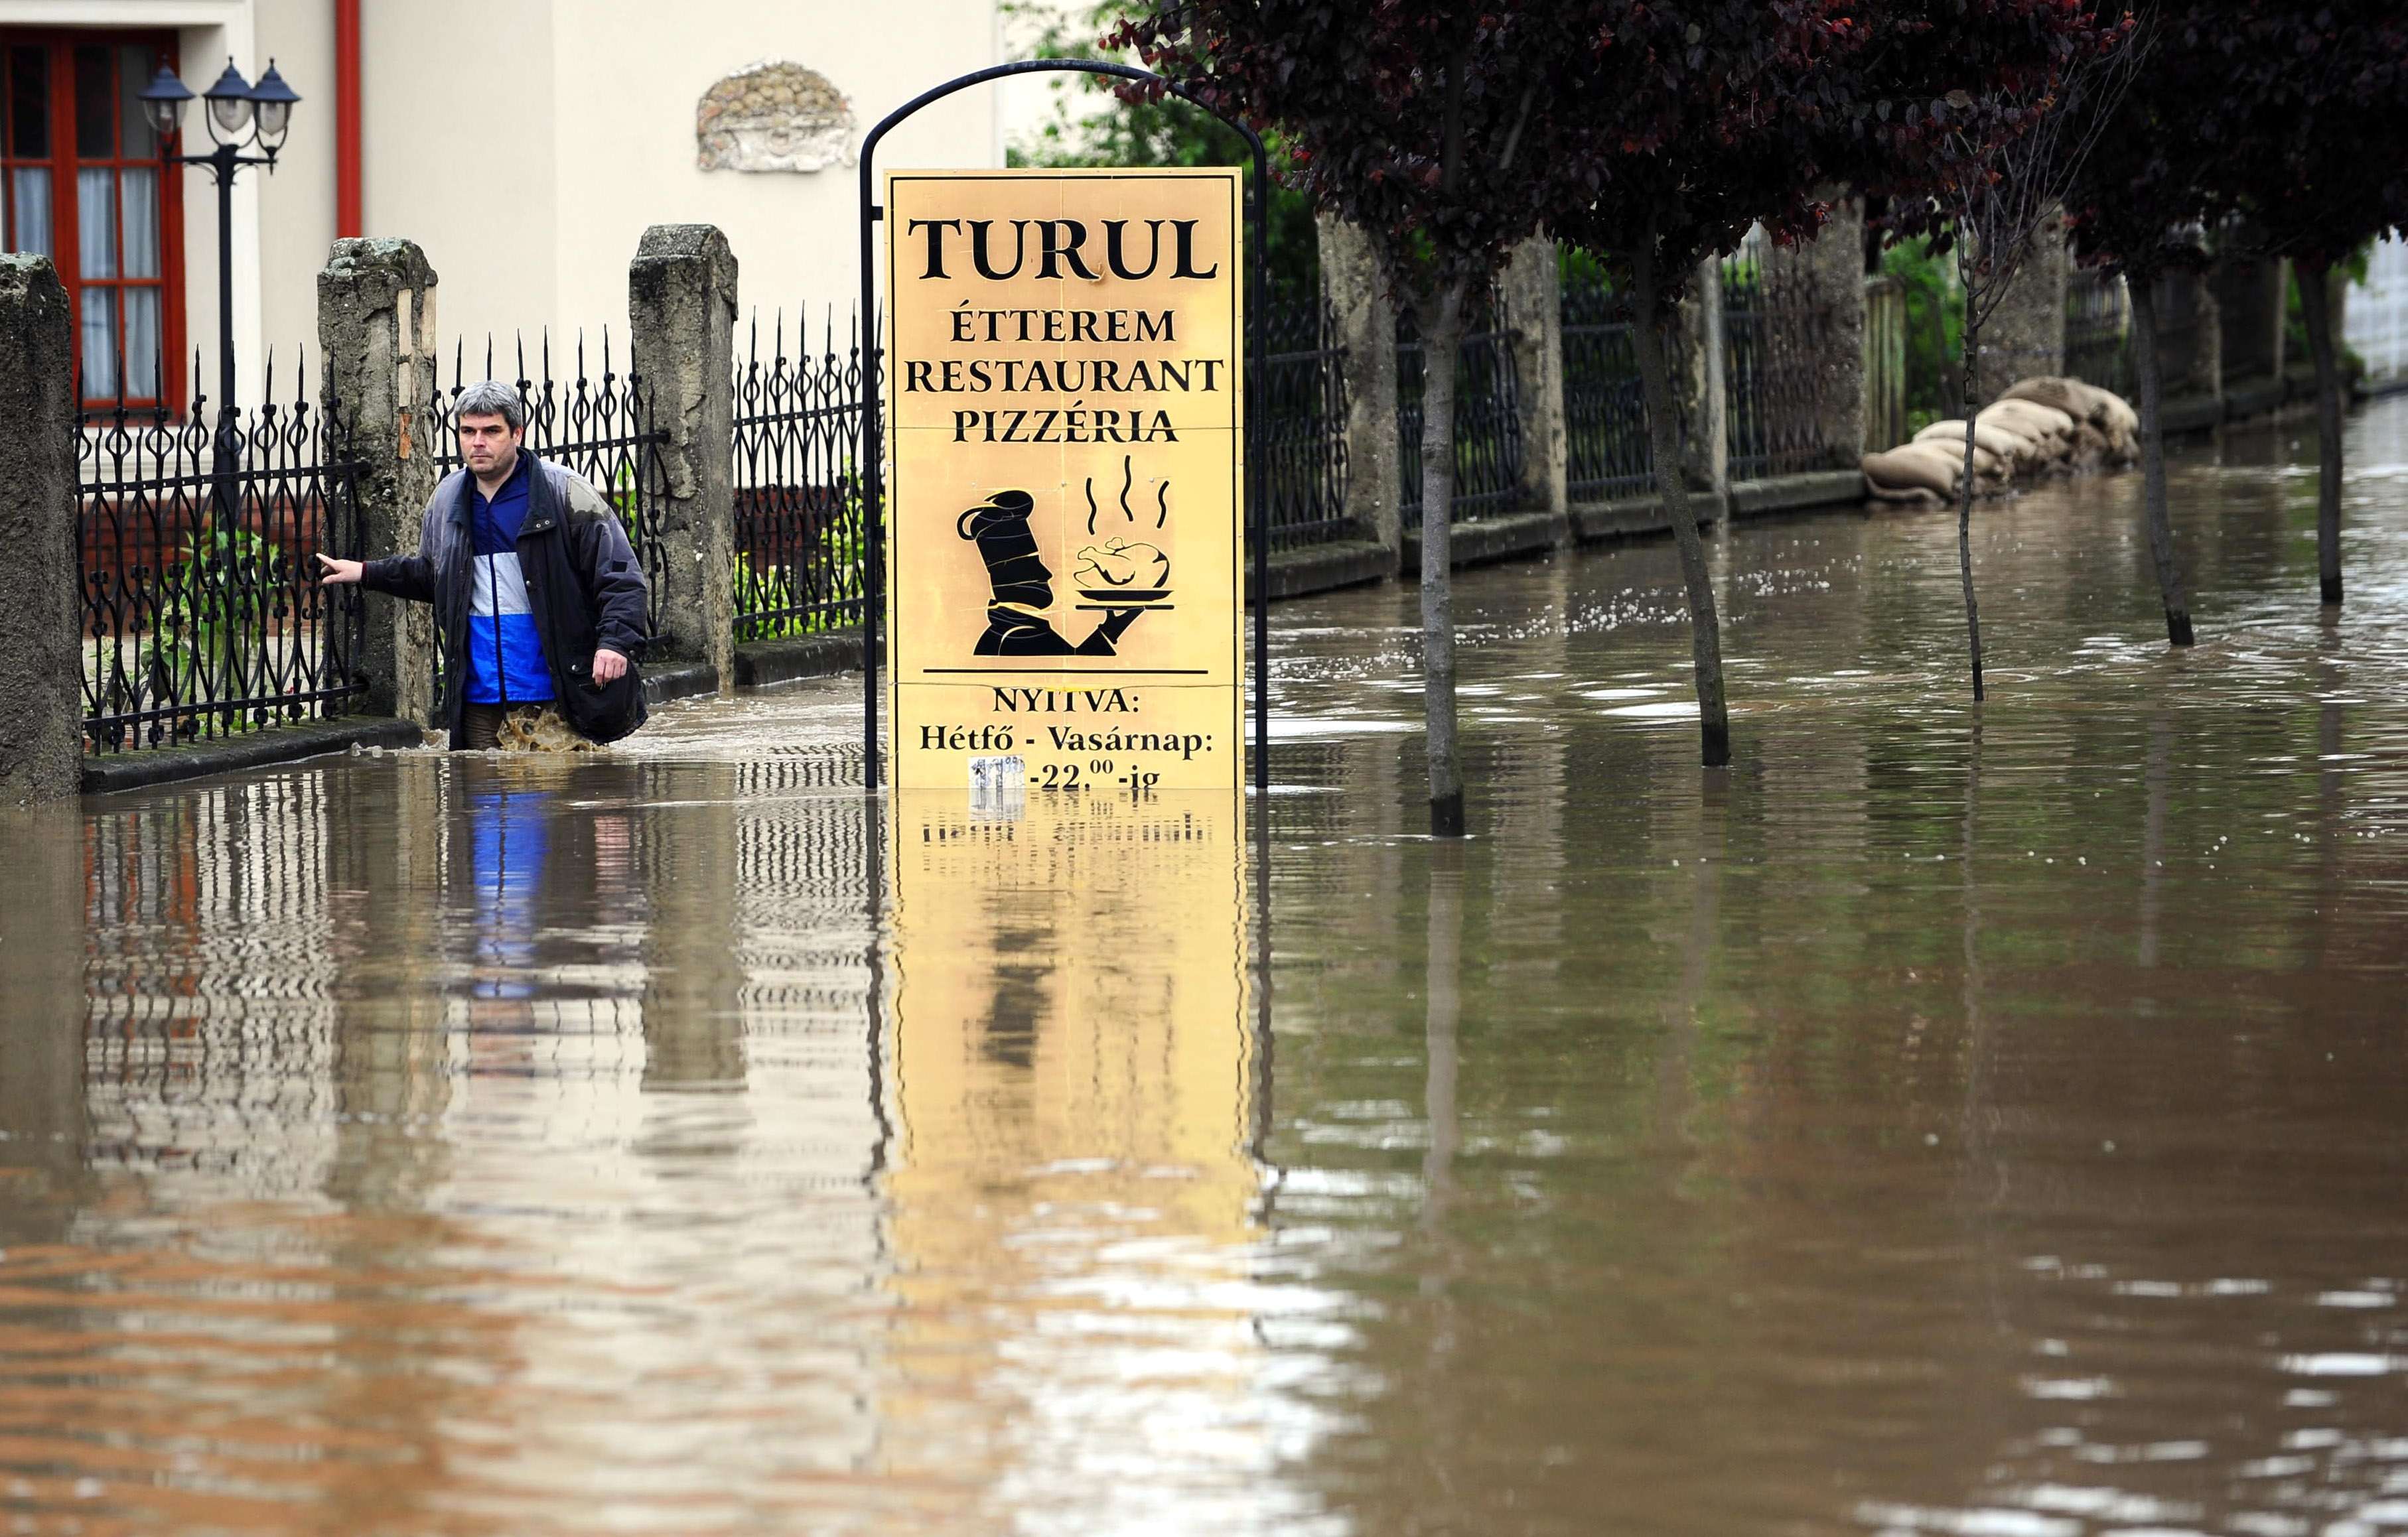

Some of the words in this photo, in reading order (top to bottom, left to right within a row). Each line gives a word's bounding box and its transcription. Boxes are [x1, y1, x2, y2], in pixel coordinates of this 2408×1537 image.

[908, 218, 1218, 281] TURUL
[950, 299, 1176, 342] ÉTTEREM
[904, 360, 1224, 392] RESTAURANT
[952, 400, 1179, 443] PIZZÉRIA
[920, 725, 1013, 750] Hétfő
[1047, 726, 1212, 760] Vasárnap:
